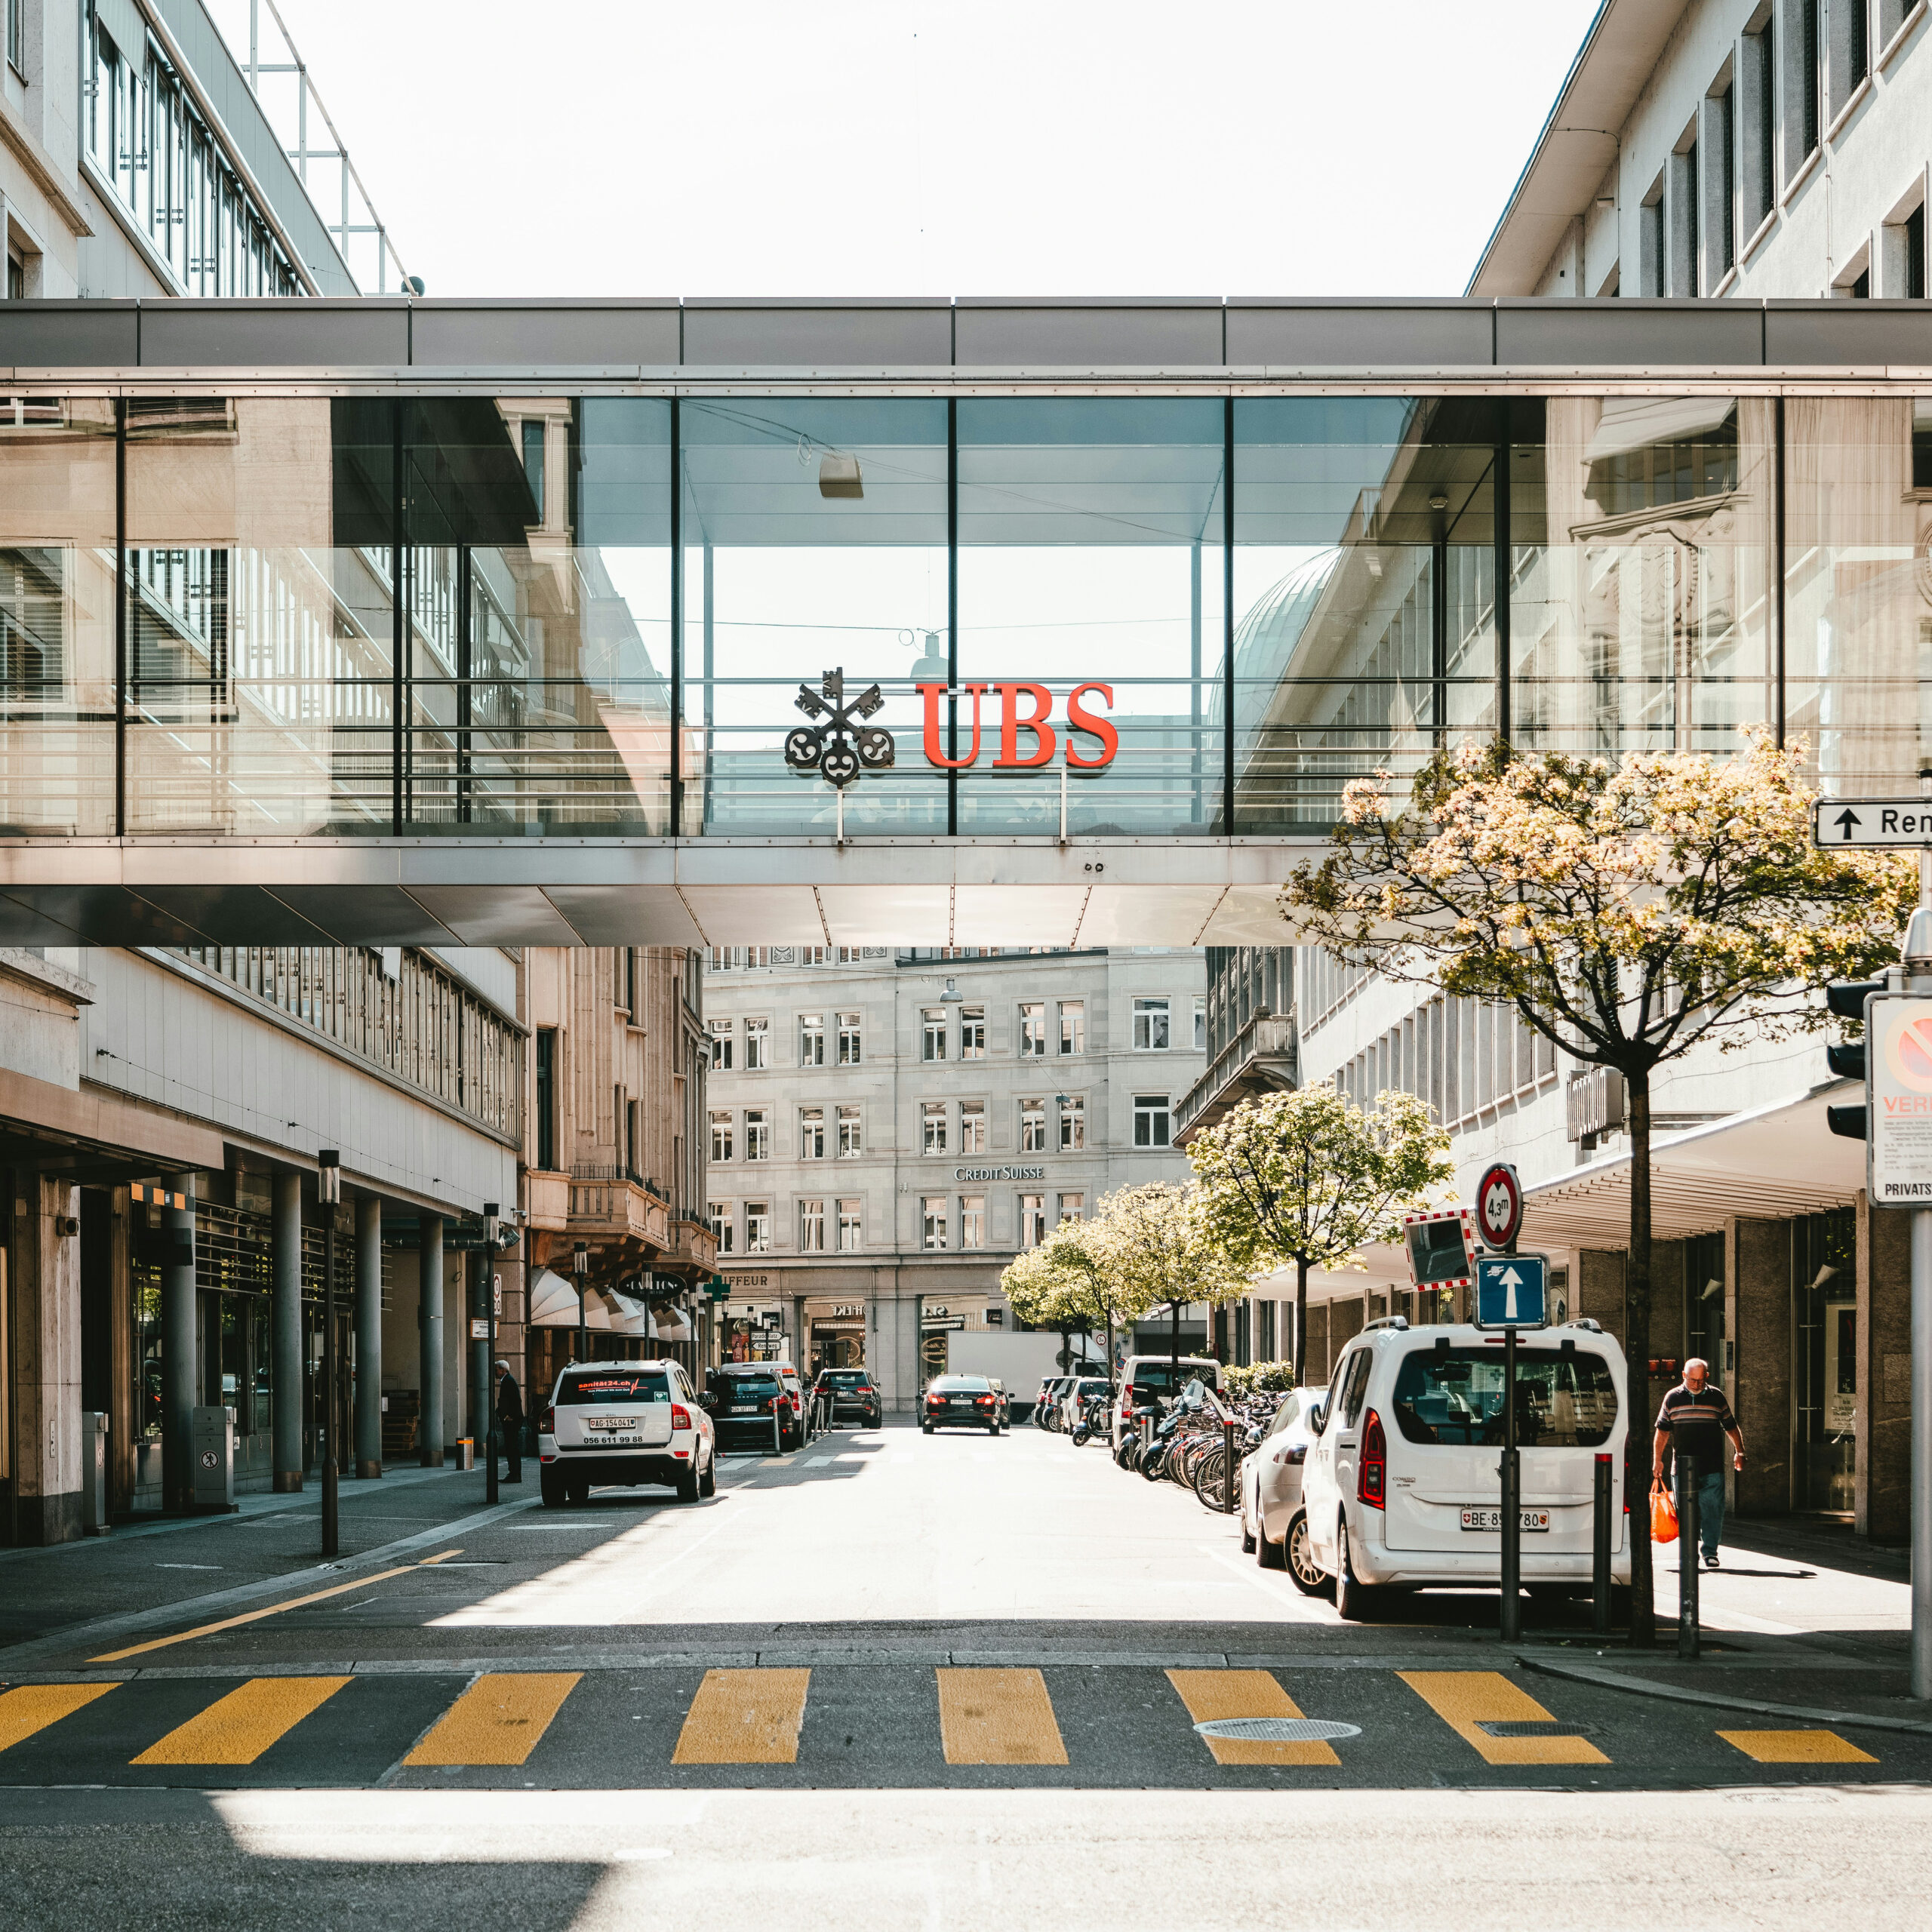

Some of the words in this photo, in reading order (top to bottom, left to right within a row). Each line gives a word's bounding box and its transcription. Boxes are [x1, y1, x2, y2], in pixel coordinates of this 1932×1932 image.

[915, 683, 1118, 768] UBS
[1881, 809, 1932, 833] Ren
[1883, 1096, 1932, 1112] VER
[954, 1167, 1000, 1181] CREDIT
[1002, 1165, 1043, 1180] SUISSE
[1885, 1183, 1932, 1196] PRIVATS
[724, 1275, 768, 1286] IFFEUR
[578, 1380, 631, 1389] sanität24.ch
